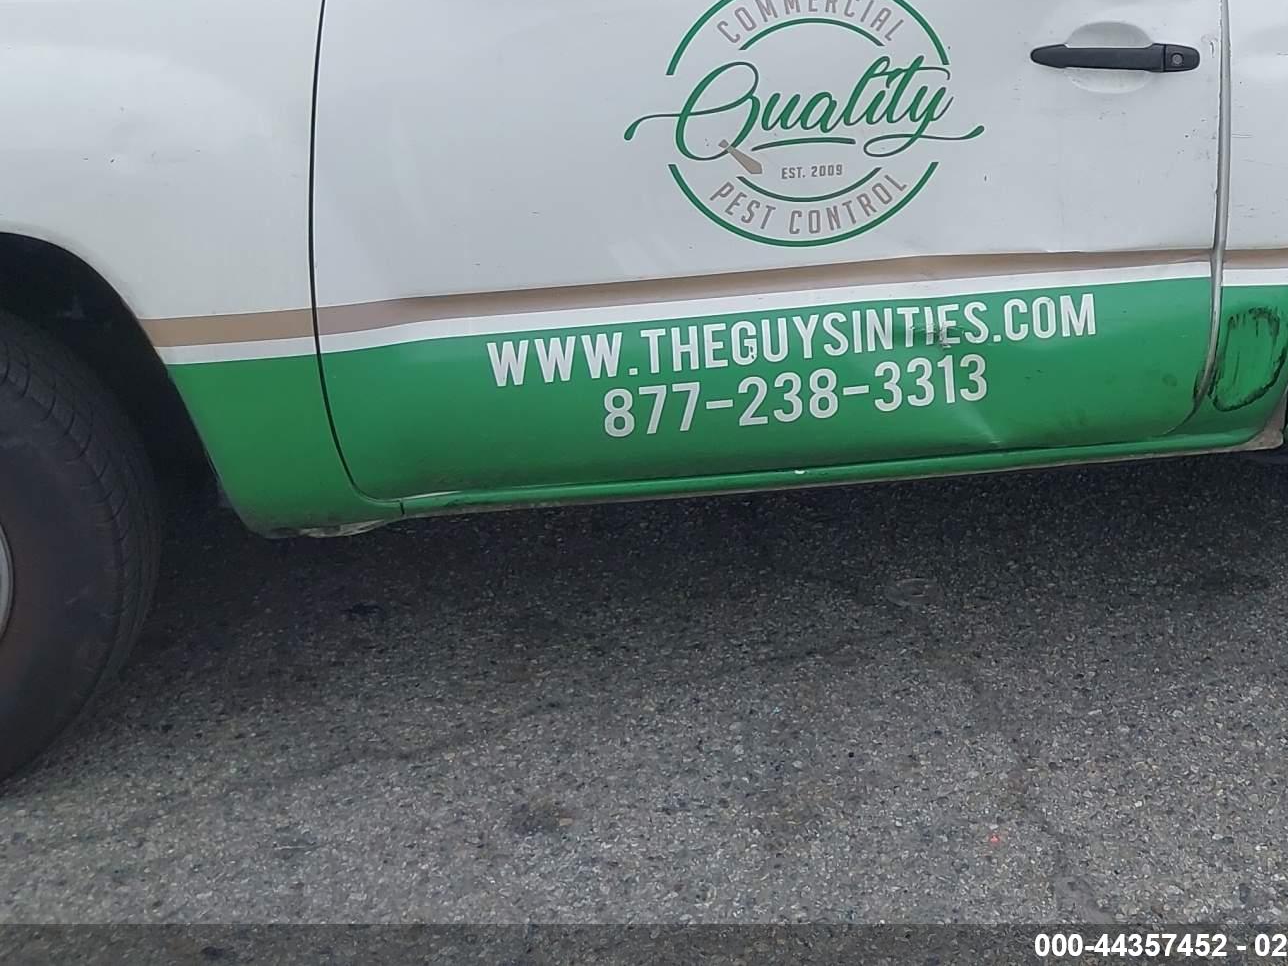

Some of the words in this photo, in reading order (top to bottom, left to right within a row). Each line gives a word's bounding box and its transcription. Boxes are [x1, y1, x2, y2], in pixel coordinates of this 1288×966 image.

[624, 55, 985, 161] Quality
[710, 181, 777, 230] PEST
[789, 173, 908, 235] CONTROL
[781, 166, 806, 180] EST.
[811, 164, 843, 178] 2009
[486, 293, 1097, 388] WWW.THEGUYSINTIES.COM
[603, 353, 989, 438] 877-238-3313
